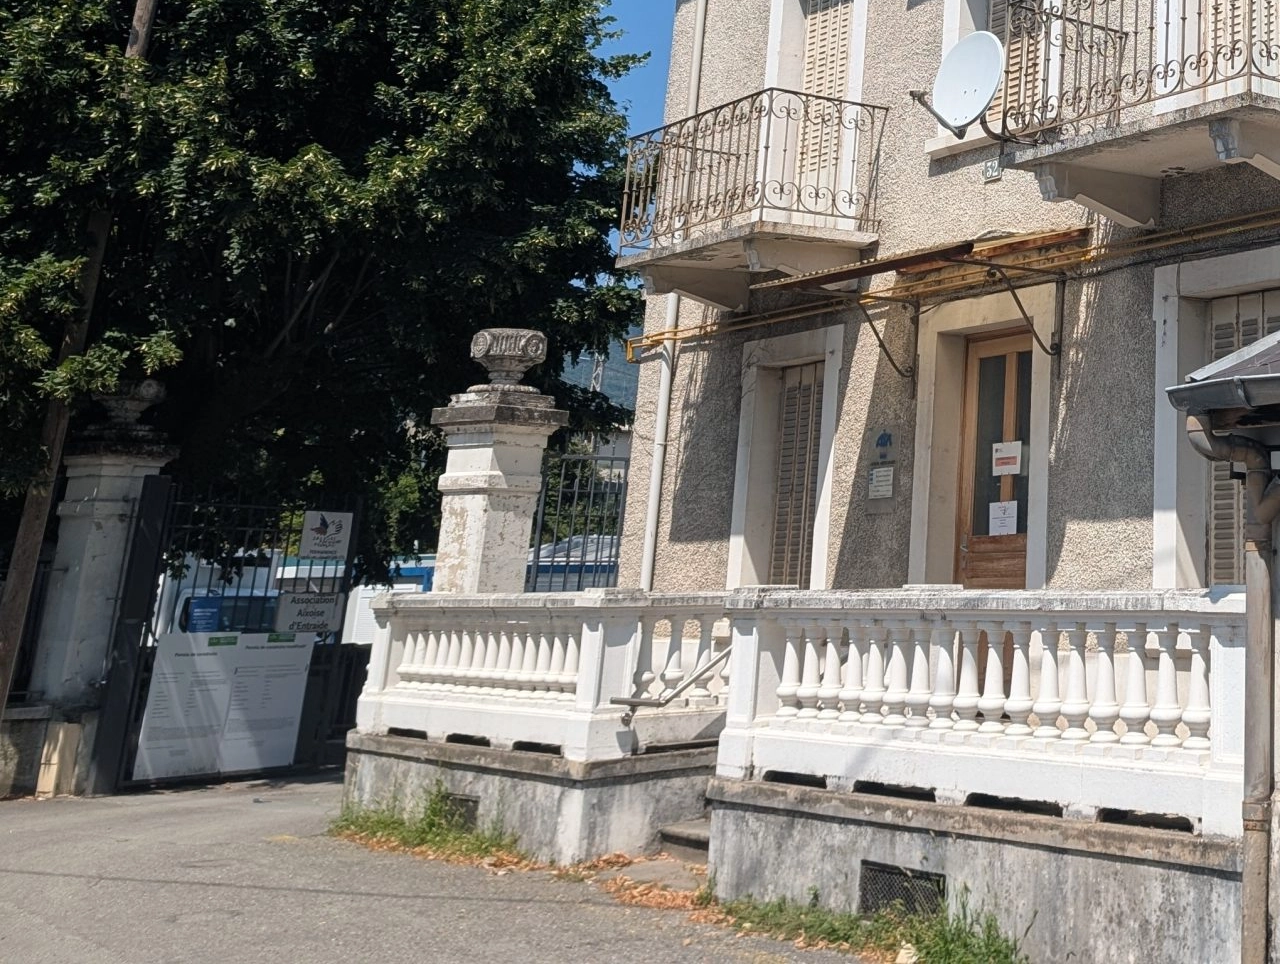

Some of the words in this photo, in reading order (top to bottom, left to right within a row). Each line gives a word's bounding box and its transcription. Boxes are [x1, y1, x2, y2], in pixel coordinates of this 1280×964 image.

[986, 160, 998, 178] 32
[290, 596, 335, 605] Association
[296, 609, 325, 617] Aixoise
[288, 621, 329, 630] d'Entraide
